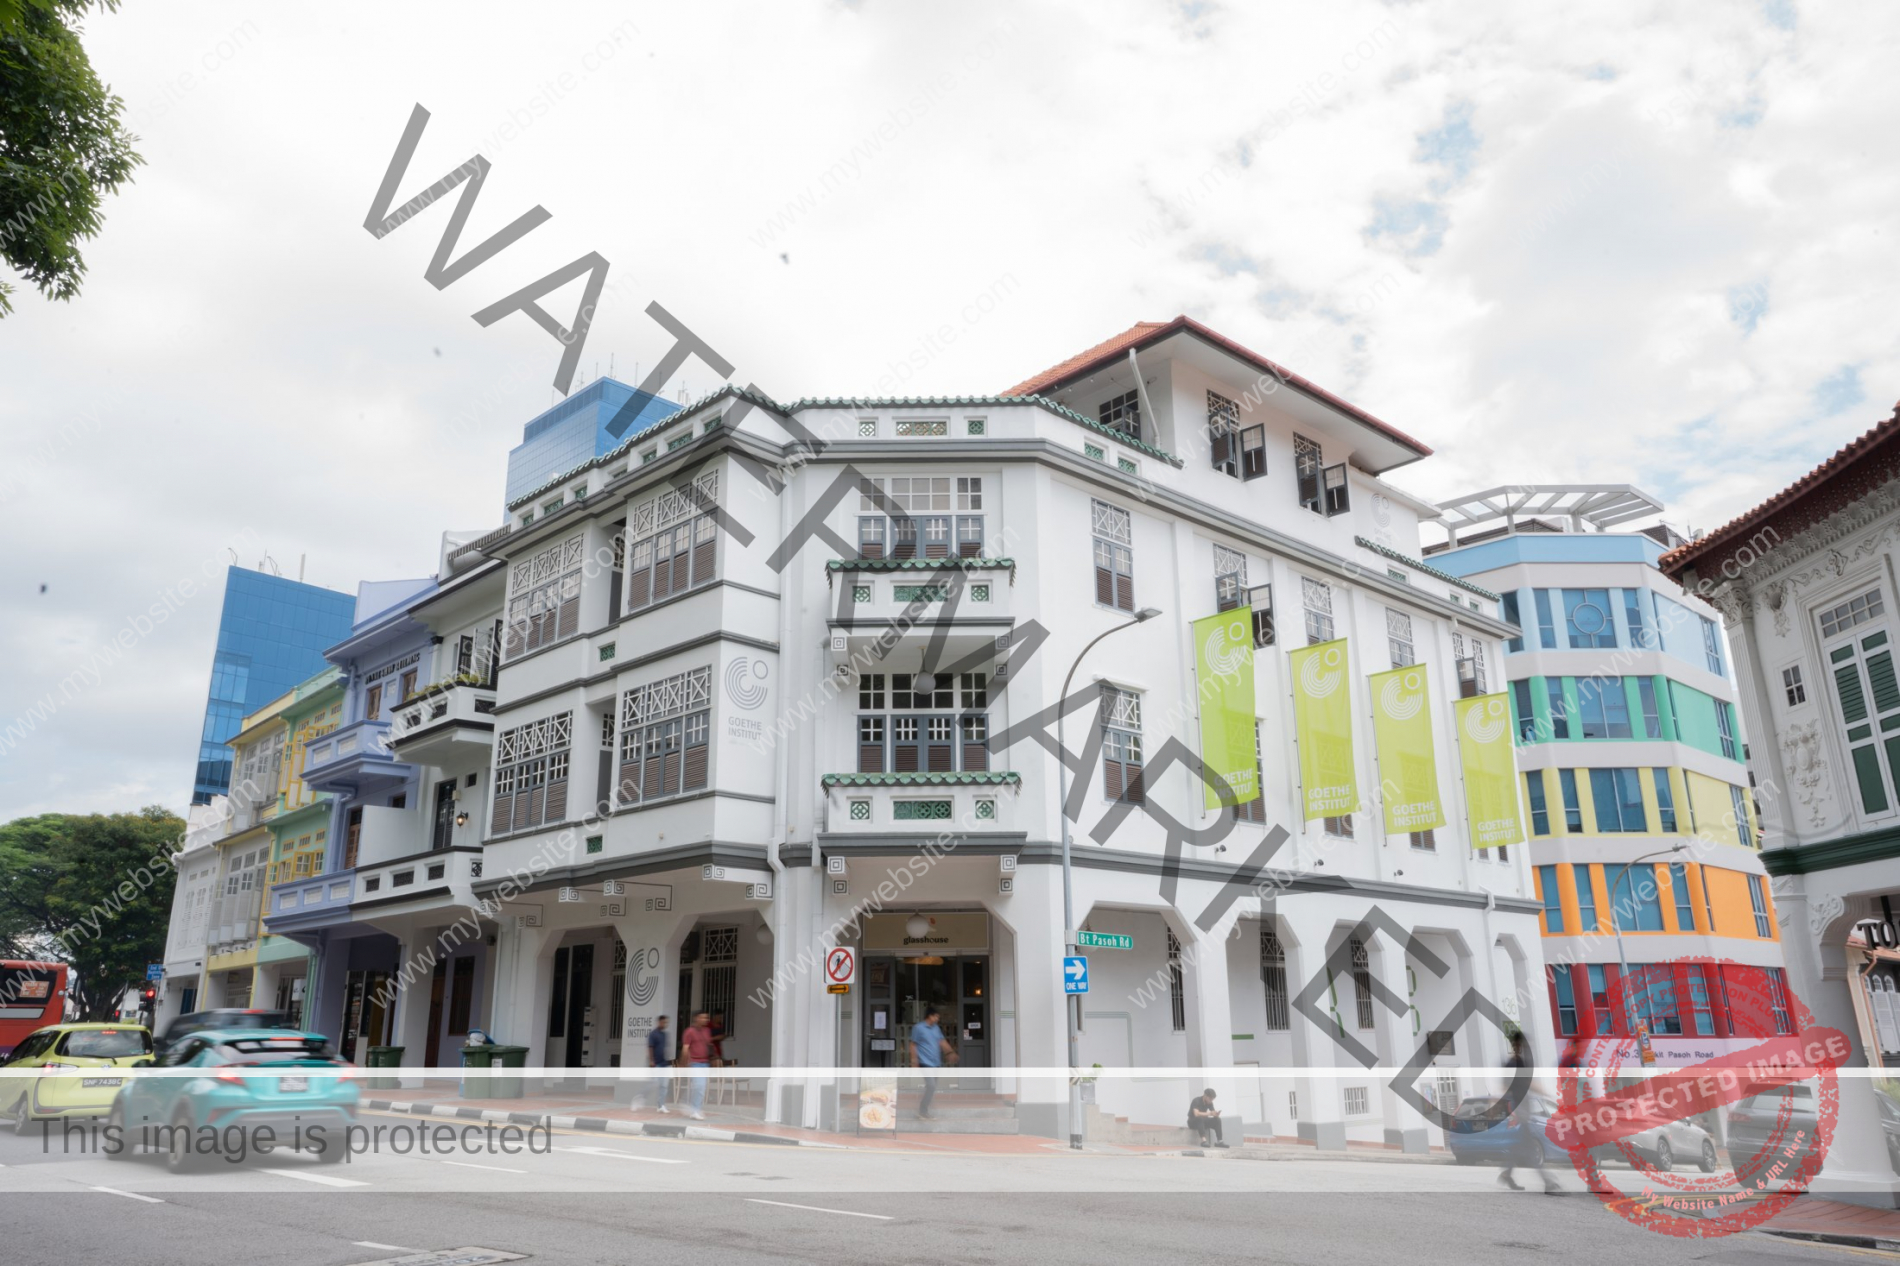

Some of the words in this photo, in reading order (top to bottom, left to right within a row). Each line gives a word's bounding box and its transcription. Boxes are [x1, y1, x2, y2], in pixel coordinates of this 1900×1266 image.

[728, 716, 762, 731] GOETHE
[728, 727, 762, 741] INSTITUT
[1214, 768, 1254, 787] GOETHE
[1214, 781, 1254, 800] INSTITUT
[1308, 785, 1351, 801] GOETHE
[1308, 798, 1351, 813] INSTITUT
[1392, 801, 1436, 816] GOETHE
[1393, 812, 1437, 828] INSTITUT
[1477, 818, 1515, 831] GOETHE
[1478, 829, 1516, 842] INSTITUT
[903, 936, 949, 945] glasshouse
[1080, 933, 1090, 945] Bt
[1092, 934, 1117, 947] Pasoh
[1119, 936, 1130, 948] Rd
[1857, 921, 1900, 950] TO
[1066, 982, 1077, 991] ONE
[627, 1016, 653, 1027] GOETHE
[1668, 1050, 1691, 1059] Pasoh
[1695, 1050, 1714, 1059] Road
